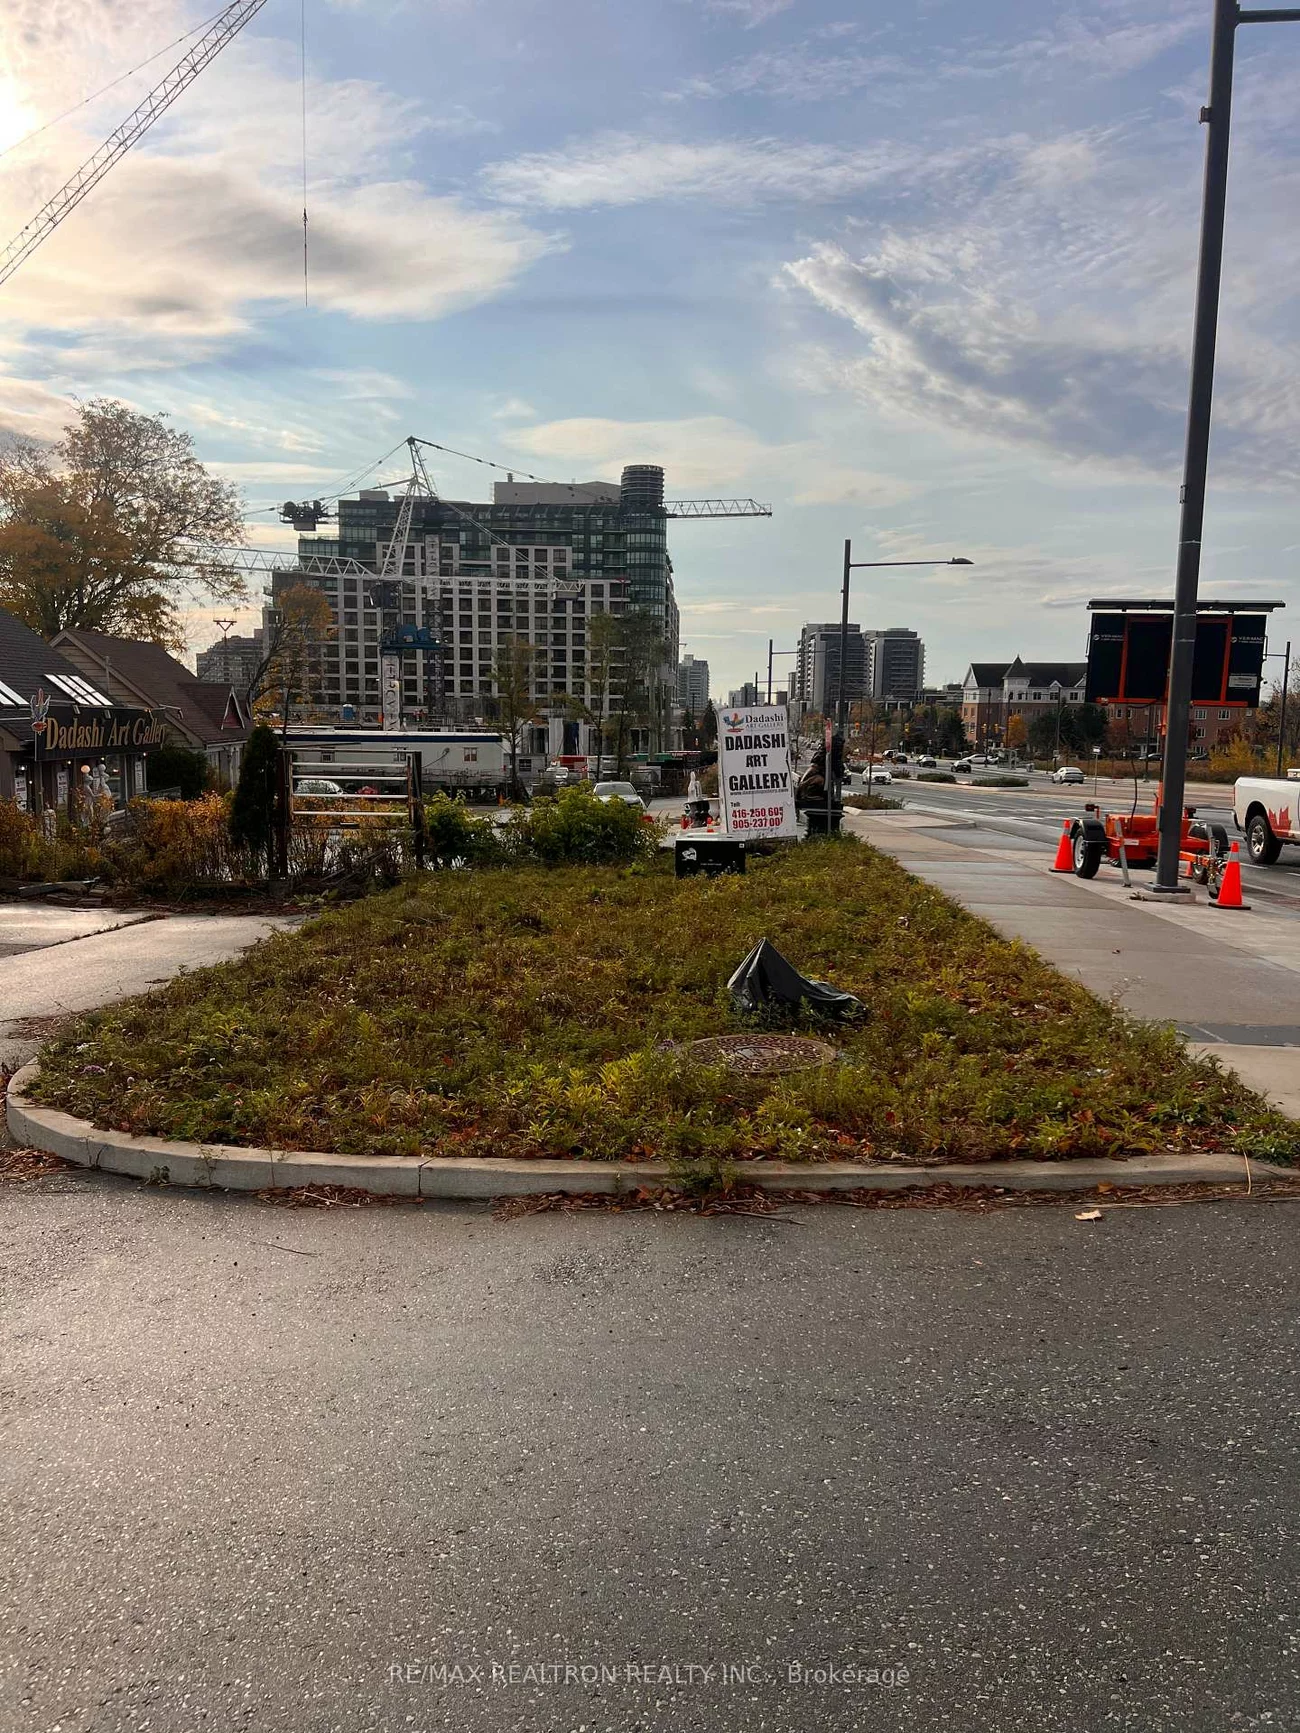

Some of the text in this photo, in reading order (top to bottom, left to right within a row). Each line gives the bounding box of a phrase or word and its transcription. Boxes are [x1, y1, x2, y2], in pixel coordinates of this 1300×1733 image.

[745, 713, 784, 723] Dadashi
[45, 717, 167, 750] Dadashi Art Gallery
[725, 733, 786, 751] DADASHI
[746, 754, 768, 768] ART
[729, 772, 788, 792] GALLERY
[732, 808, 767, 818] 416-250
[732, 817, 769, 829] 905-237
